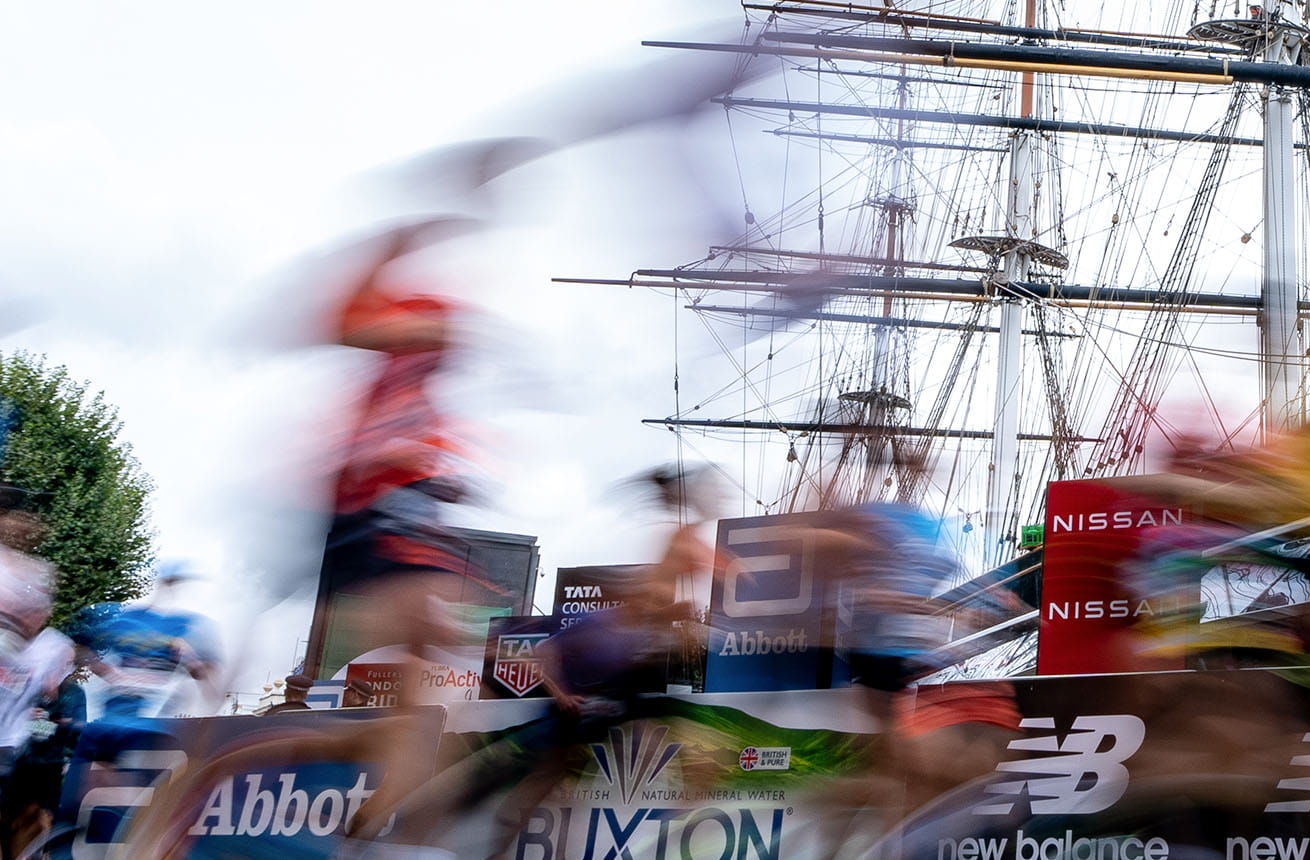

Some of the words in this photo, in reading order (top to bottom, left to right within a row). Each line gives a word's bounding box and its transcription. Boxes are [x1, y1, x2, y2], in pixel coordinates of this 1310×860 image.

[1053, 508, 1183, 533] NISSAN
[564, 585, 602, 599] TATA
[1048, 599, 1179, 621] NISSA
[503, 639, 541, 657] TA
[718, 628, 809, 657] Abbott
[498, 662, 544, 692] HEUE
[188, 771, 396, 837] Abbot
[641, 790, 691, 800] NATURAL
[695, 790, 742, 800] MINERAL
[747, 790, 785, 800] WATER
[515, 808, 784, 860] BUXTON
[938, 836, 1008, 860] new
[1015, 829, 1170, 860] balance
[1226, 836, 1310, 860] new
